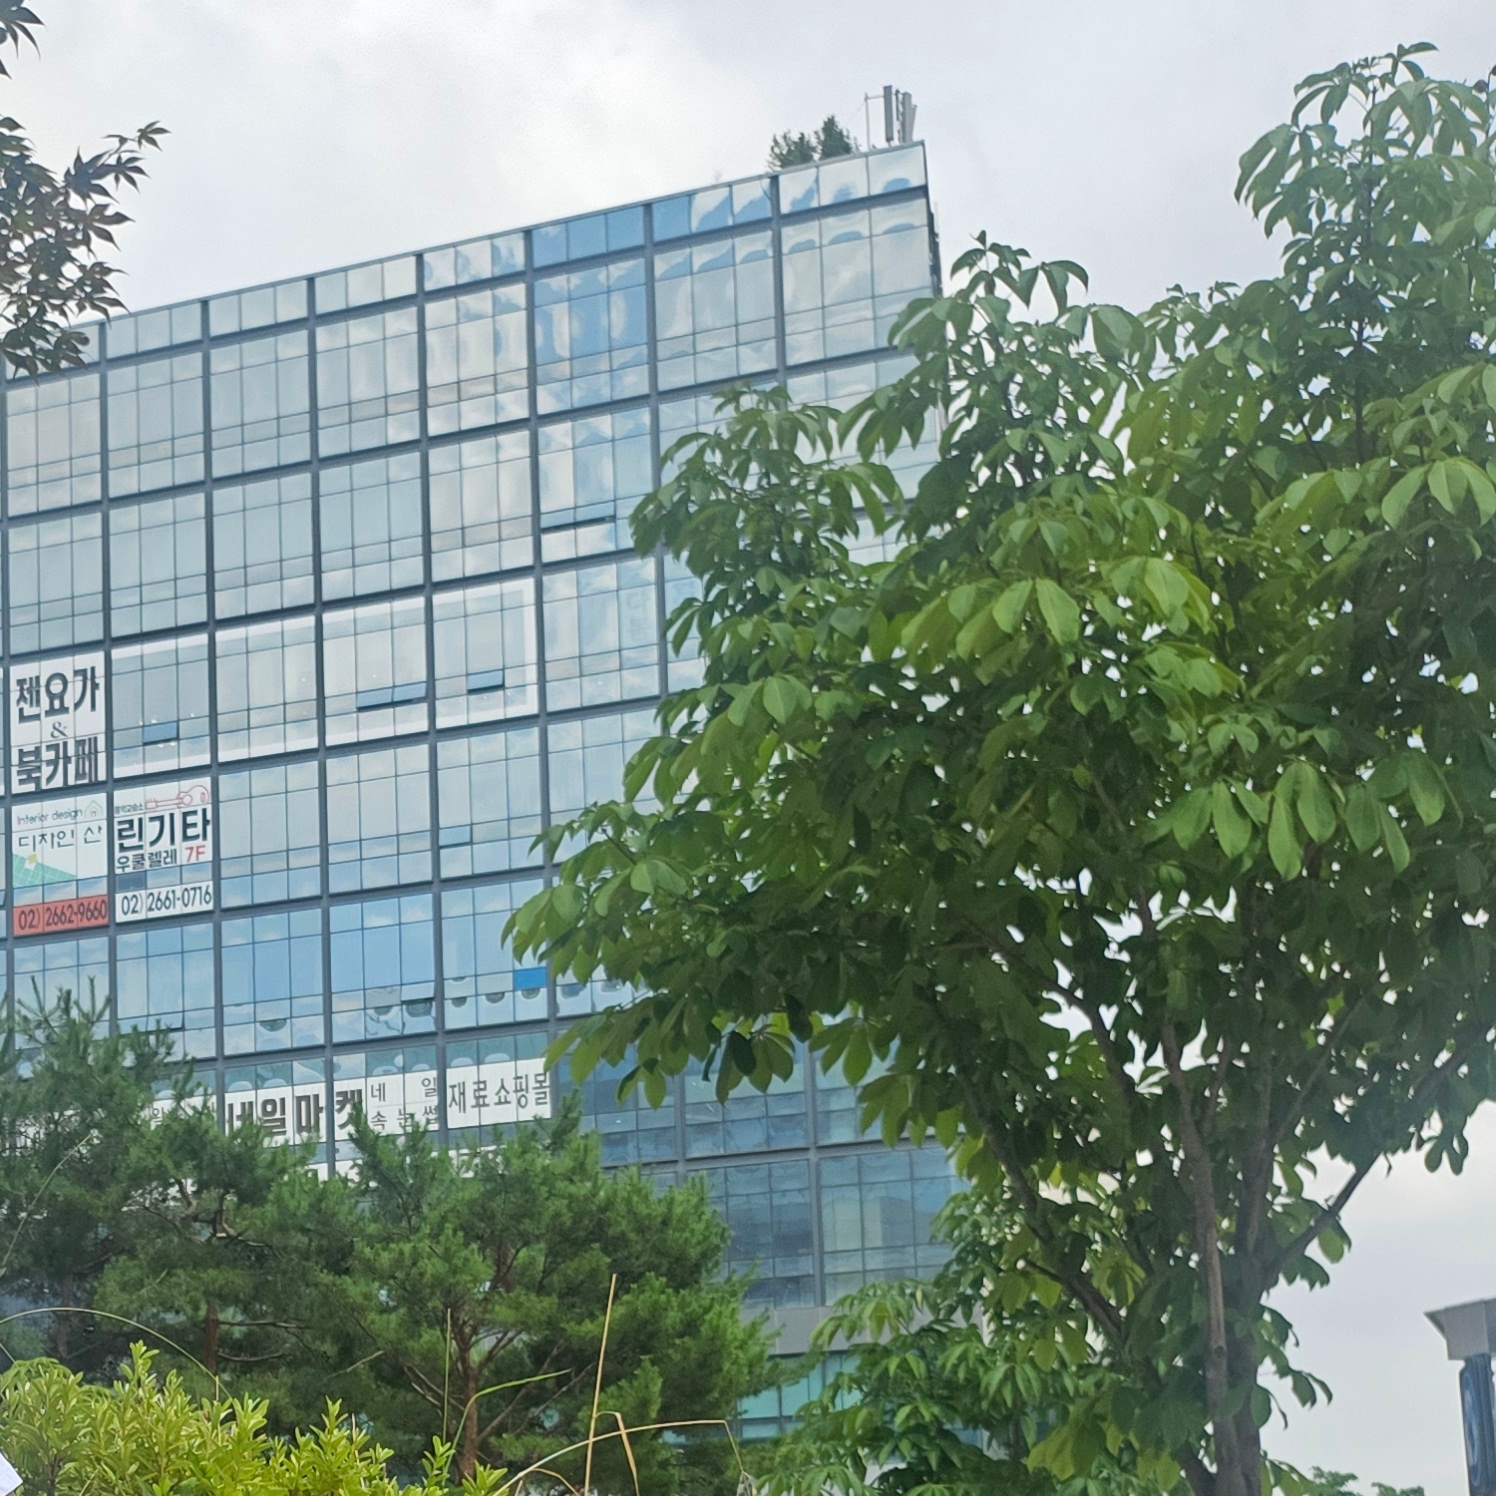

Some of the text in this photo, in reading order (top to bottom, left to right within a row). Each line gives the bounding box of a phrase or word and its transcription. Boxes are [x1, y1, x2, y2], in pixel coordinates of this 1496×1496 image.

[16, 666, 100, 724] 젠요가
[50, 721, 69, 739] &
[16, 736, 99, 792] 북카페
[16, 808, 83, 826] Interior design
[116, 807, 211, 854] 린기타
[18, 825, 103, 852] 디자인 산
[116, 848, 178, 873] 우쿨렐레
[184, 844, 206, 863] 7F
[448, 1072, 551, 1114] 재료쇼핑몰
